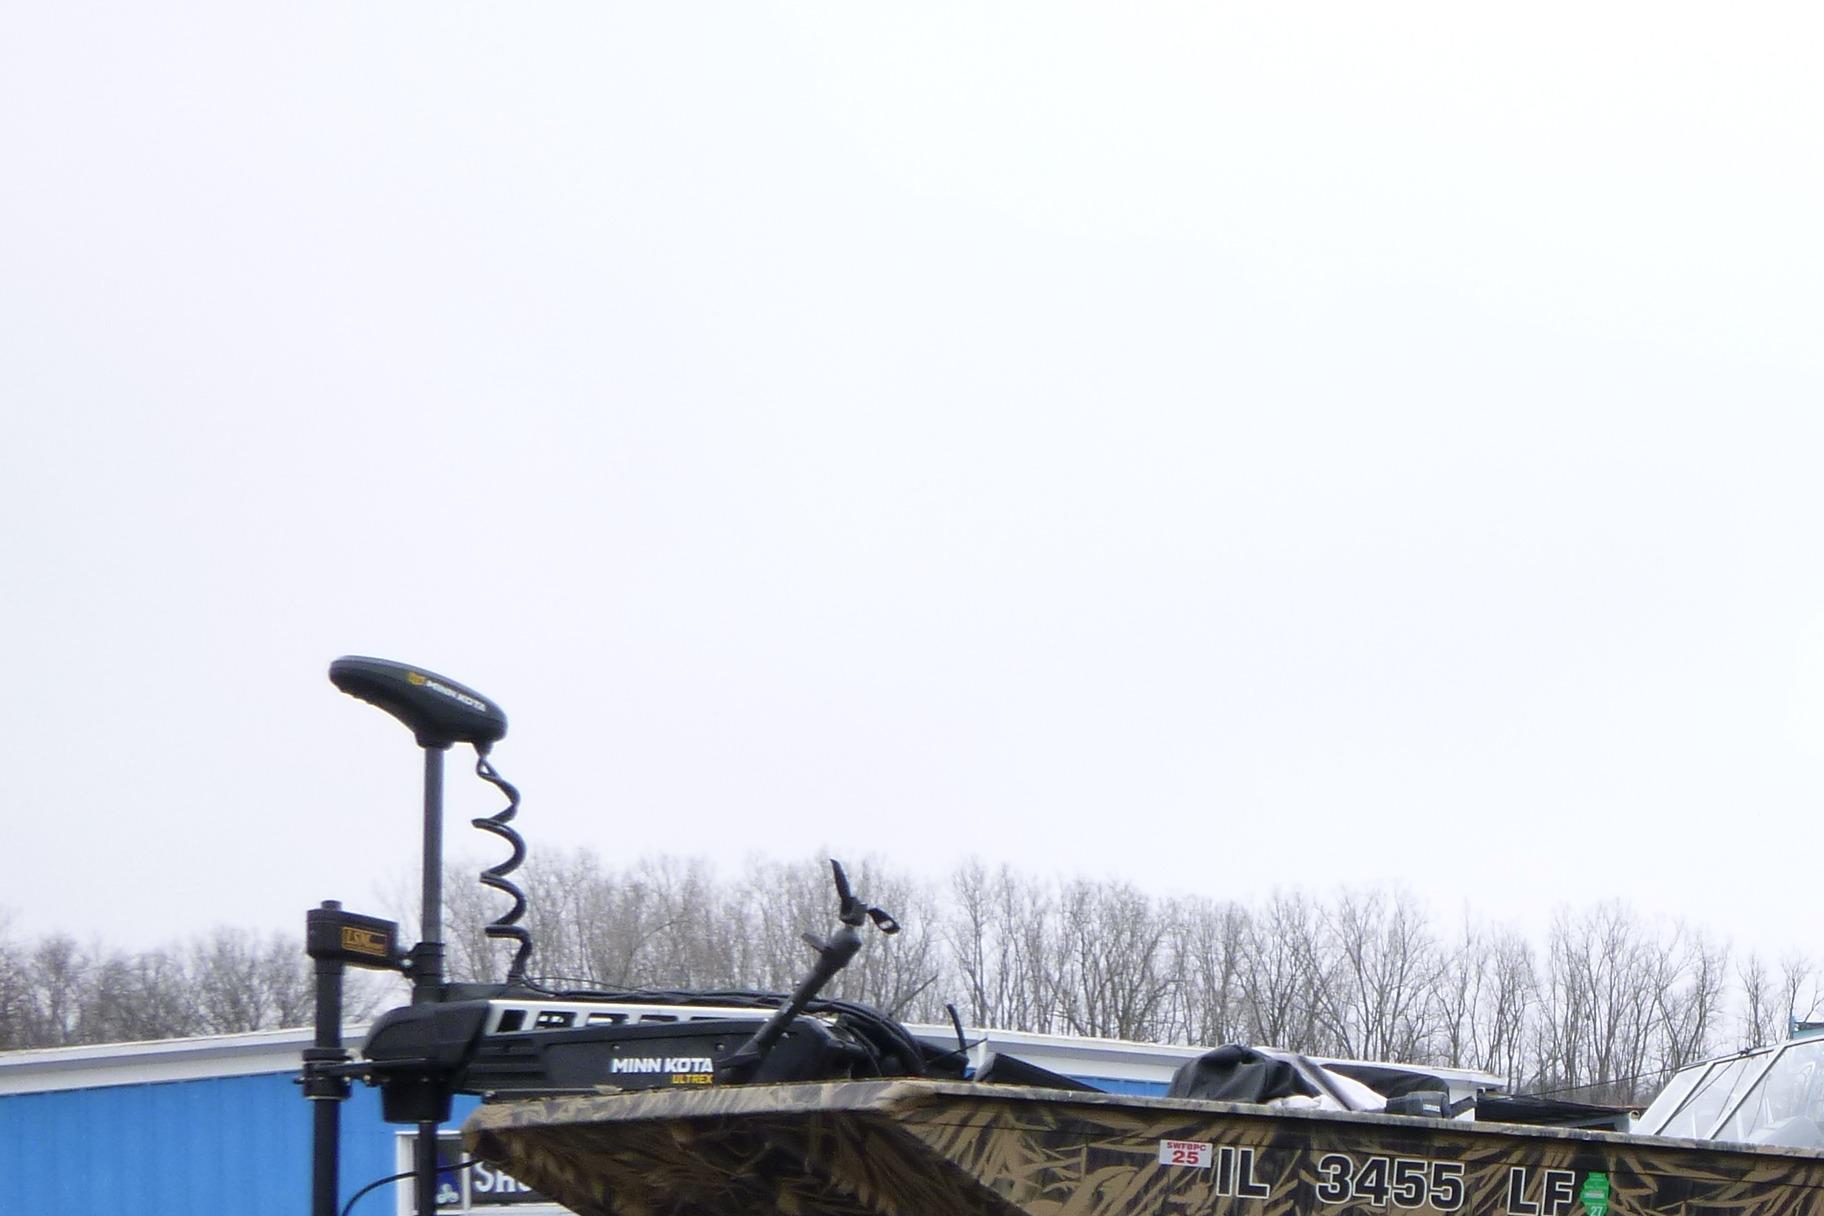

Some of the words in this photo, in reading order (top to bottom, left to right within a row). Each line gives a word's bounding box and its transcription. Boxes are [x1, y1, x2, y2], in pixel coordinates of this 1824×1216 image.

[611, 1057, 663, 1073] MINN
[663, 1057, 714, 1073] KOTA
[672, 1074, 713, 1085] ULTREX
[1172, 1150, 1199, 1165] 25
[1216, 1146, 1270, 1200] IL
[1315, 1153, 1466, 1212] 3455
